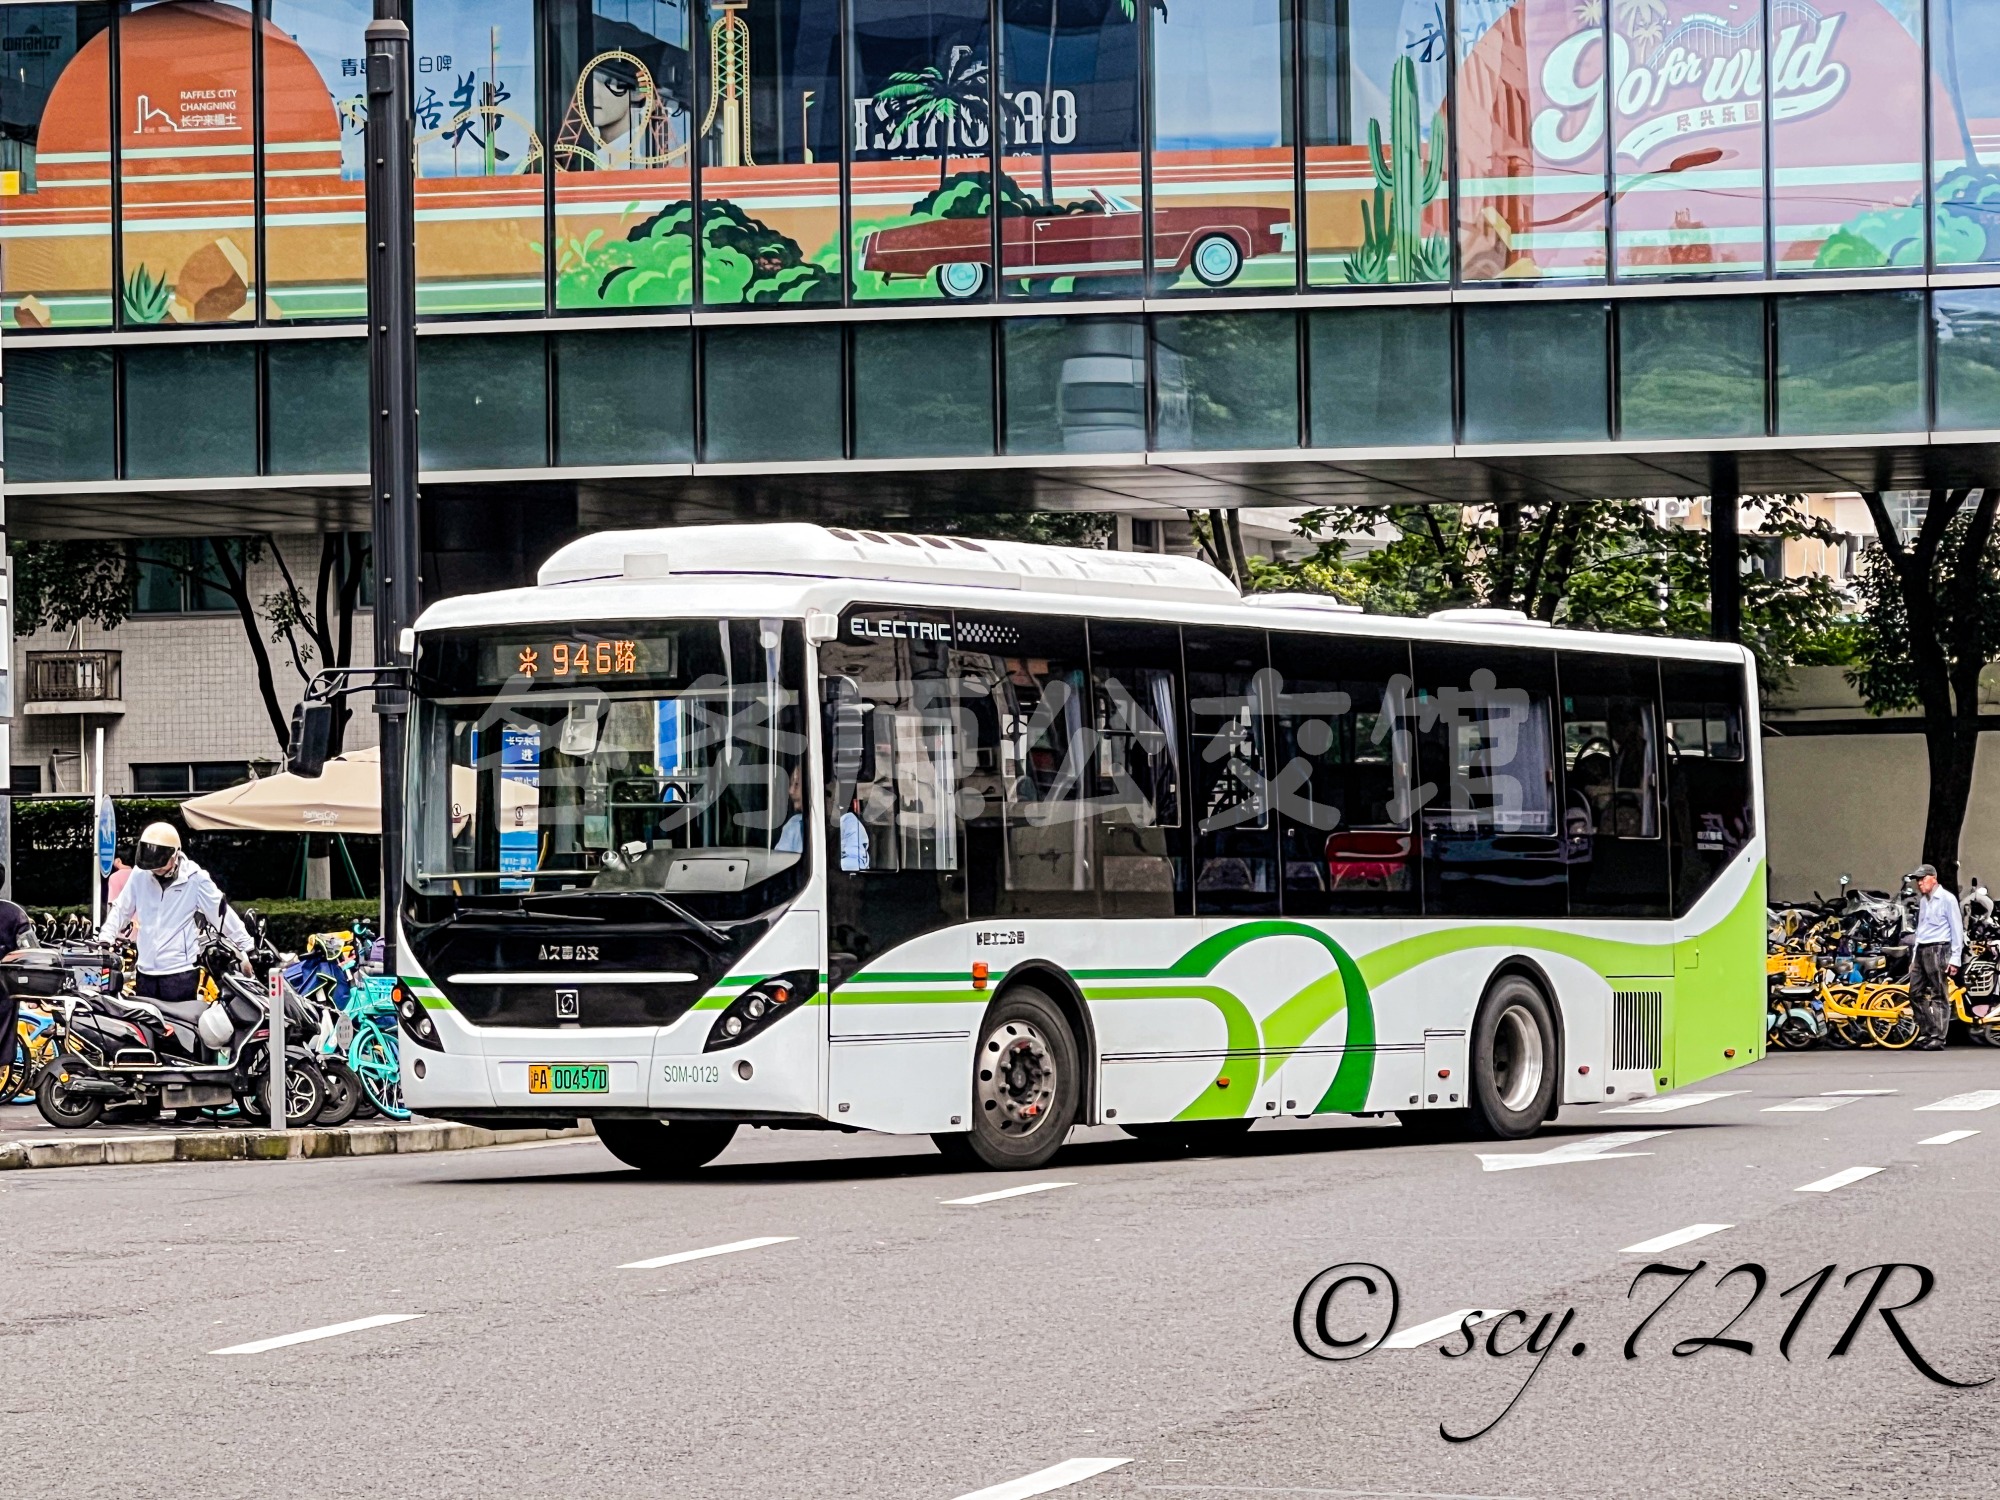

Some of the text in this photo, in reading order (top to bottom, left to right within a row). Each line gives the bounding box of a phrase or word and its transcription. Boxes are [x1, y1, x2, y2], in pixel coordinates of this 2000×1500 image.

[180, 89, 238, 100] RAFFLES CITY
[1531, 27, 1653, 161] go
[1650, 47, 1703, 108] for
[180, 101, 236, 112] CHANGNING
[181, 113, 237, 127] 长宁来福士
[854, 90, 1078, 150] TSINGAO
[851, 618, 952, 641] ELECTRIC
[553, 640, 637, 675] 946路
